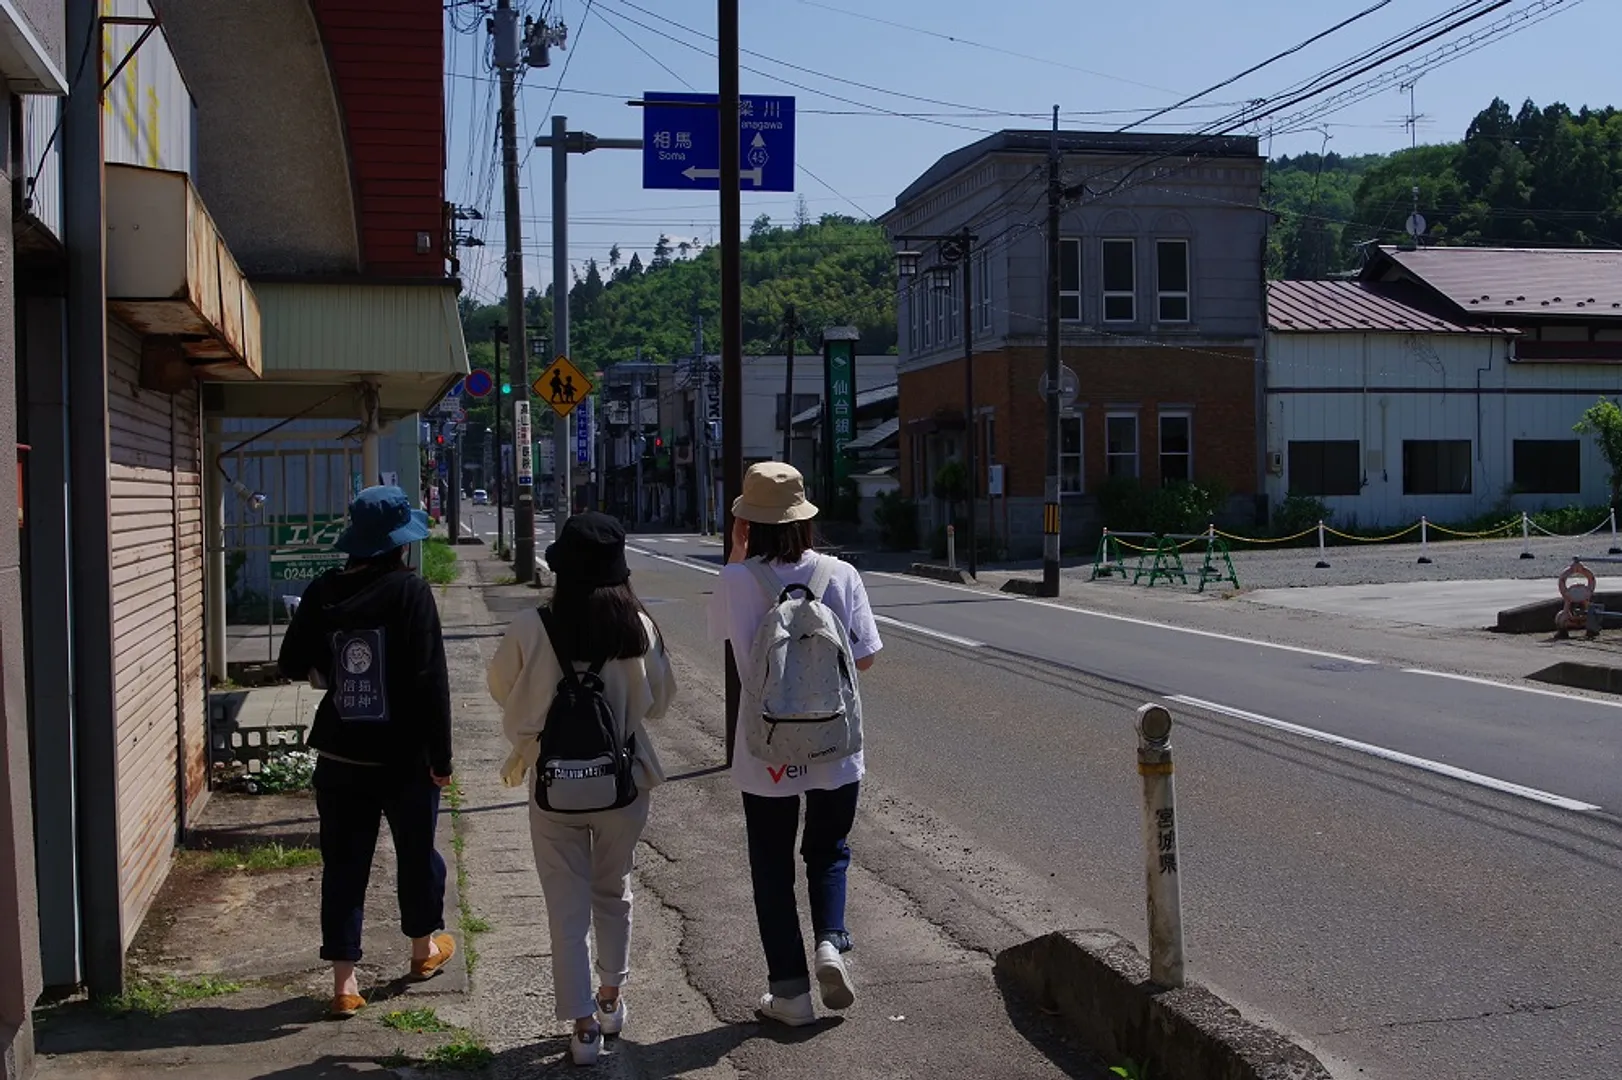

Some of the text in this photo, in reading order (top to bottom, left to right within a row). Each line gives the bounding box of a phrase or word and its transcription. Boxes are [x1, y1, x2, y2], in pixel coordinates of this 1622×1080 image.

[741, 120, 783, 131] anagawa
[653, 131, 692, 149] 相馬
[658, 151, 686, 161] Soma
[752, 151, 765, 163] 45
[1156, 808, 1178, 874] 宮城県
